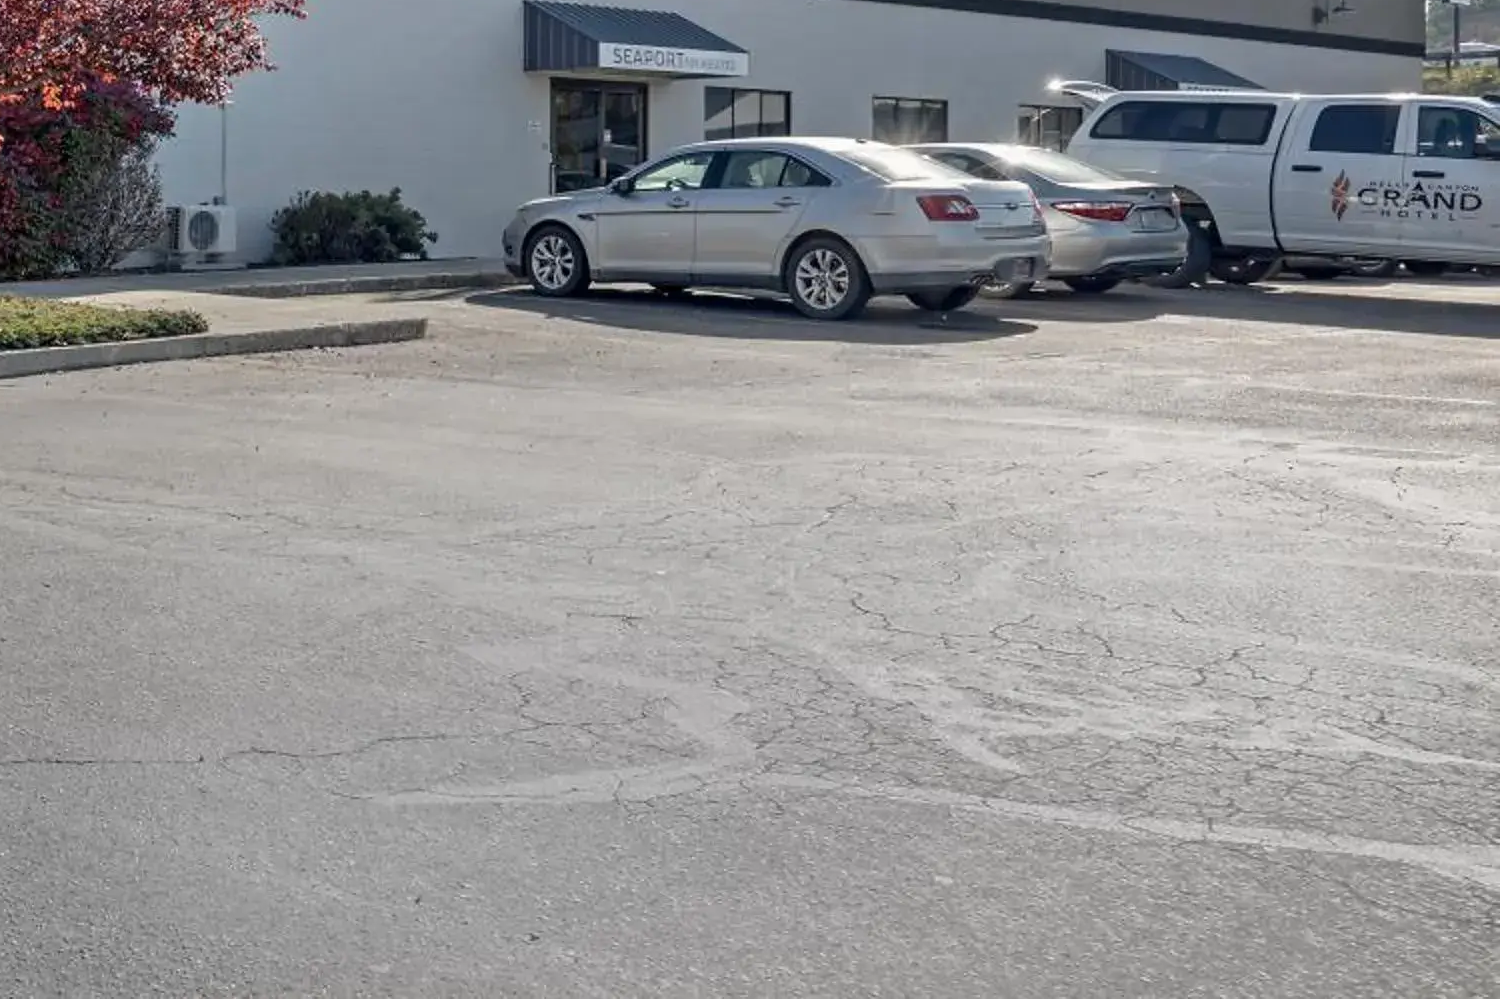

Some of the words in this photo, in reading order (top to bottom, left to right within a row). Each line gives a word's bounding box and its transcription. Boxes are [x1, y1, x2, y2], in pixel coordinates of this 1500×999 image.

[612, 47, 684, 69] SEAPORT
[1357, 181, 1483, 212] GRAND
[1380, 209, 1457, 221] HOTEL
